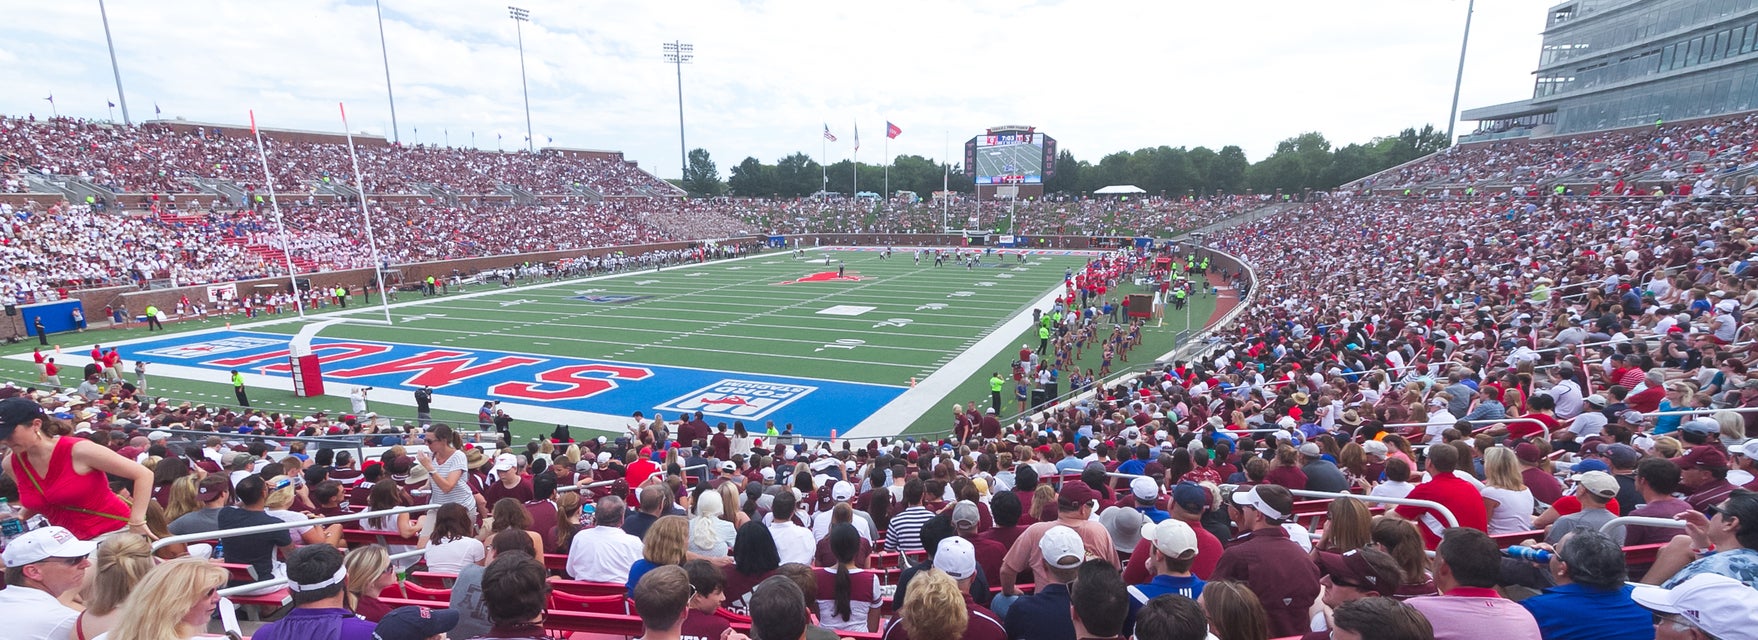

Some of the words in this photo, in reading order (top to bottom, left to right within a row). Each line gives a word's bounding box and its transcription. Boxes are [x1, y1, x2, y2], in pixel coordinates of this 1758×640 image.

[198, 342, 655, 402] SMU
[714, 386, 794, 399] FORD
[722, 381, 805, 393] STADIUM
